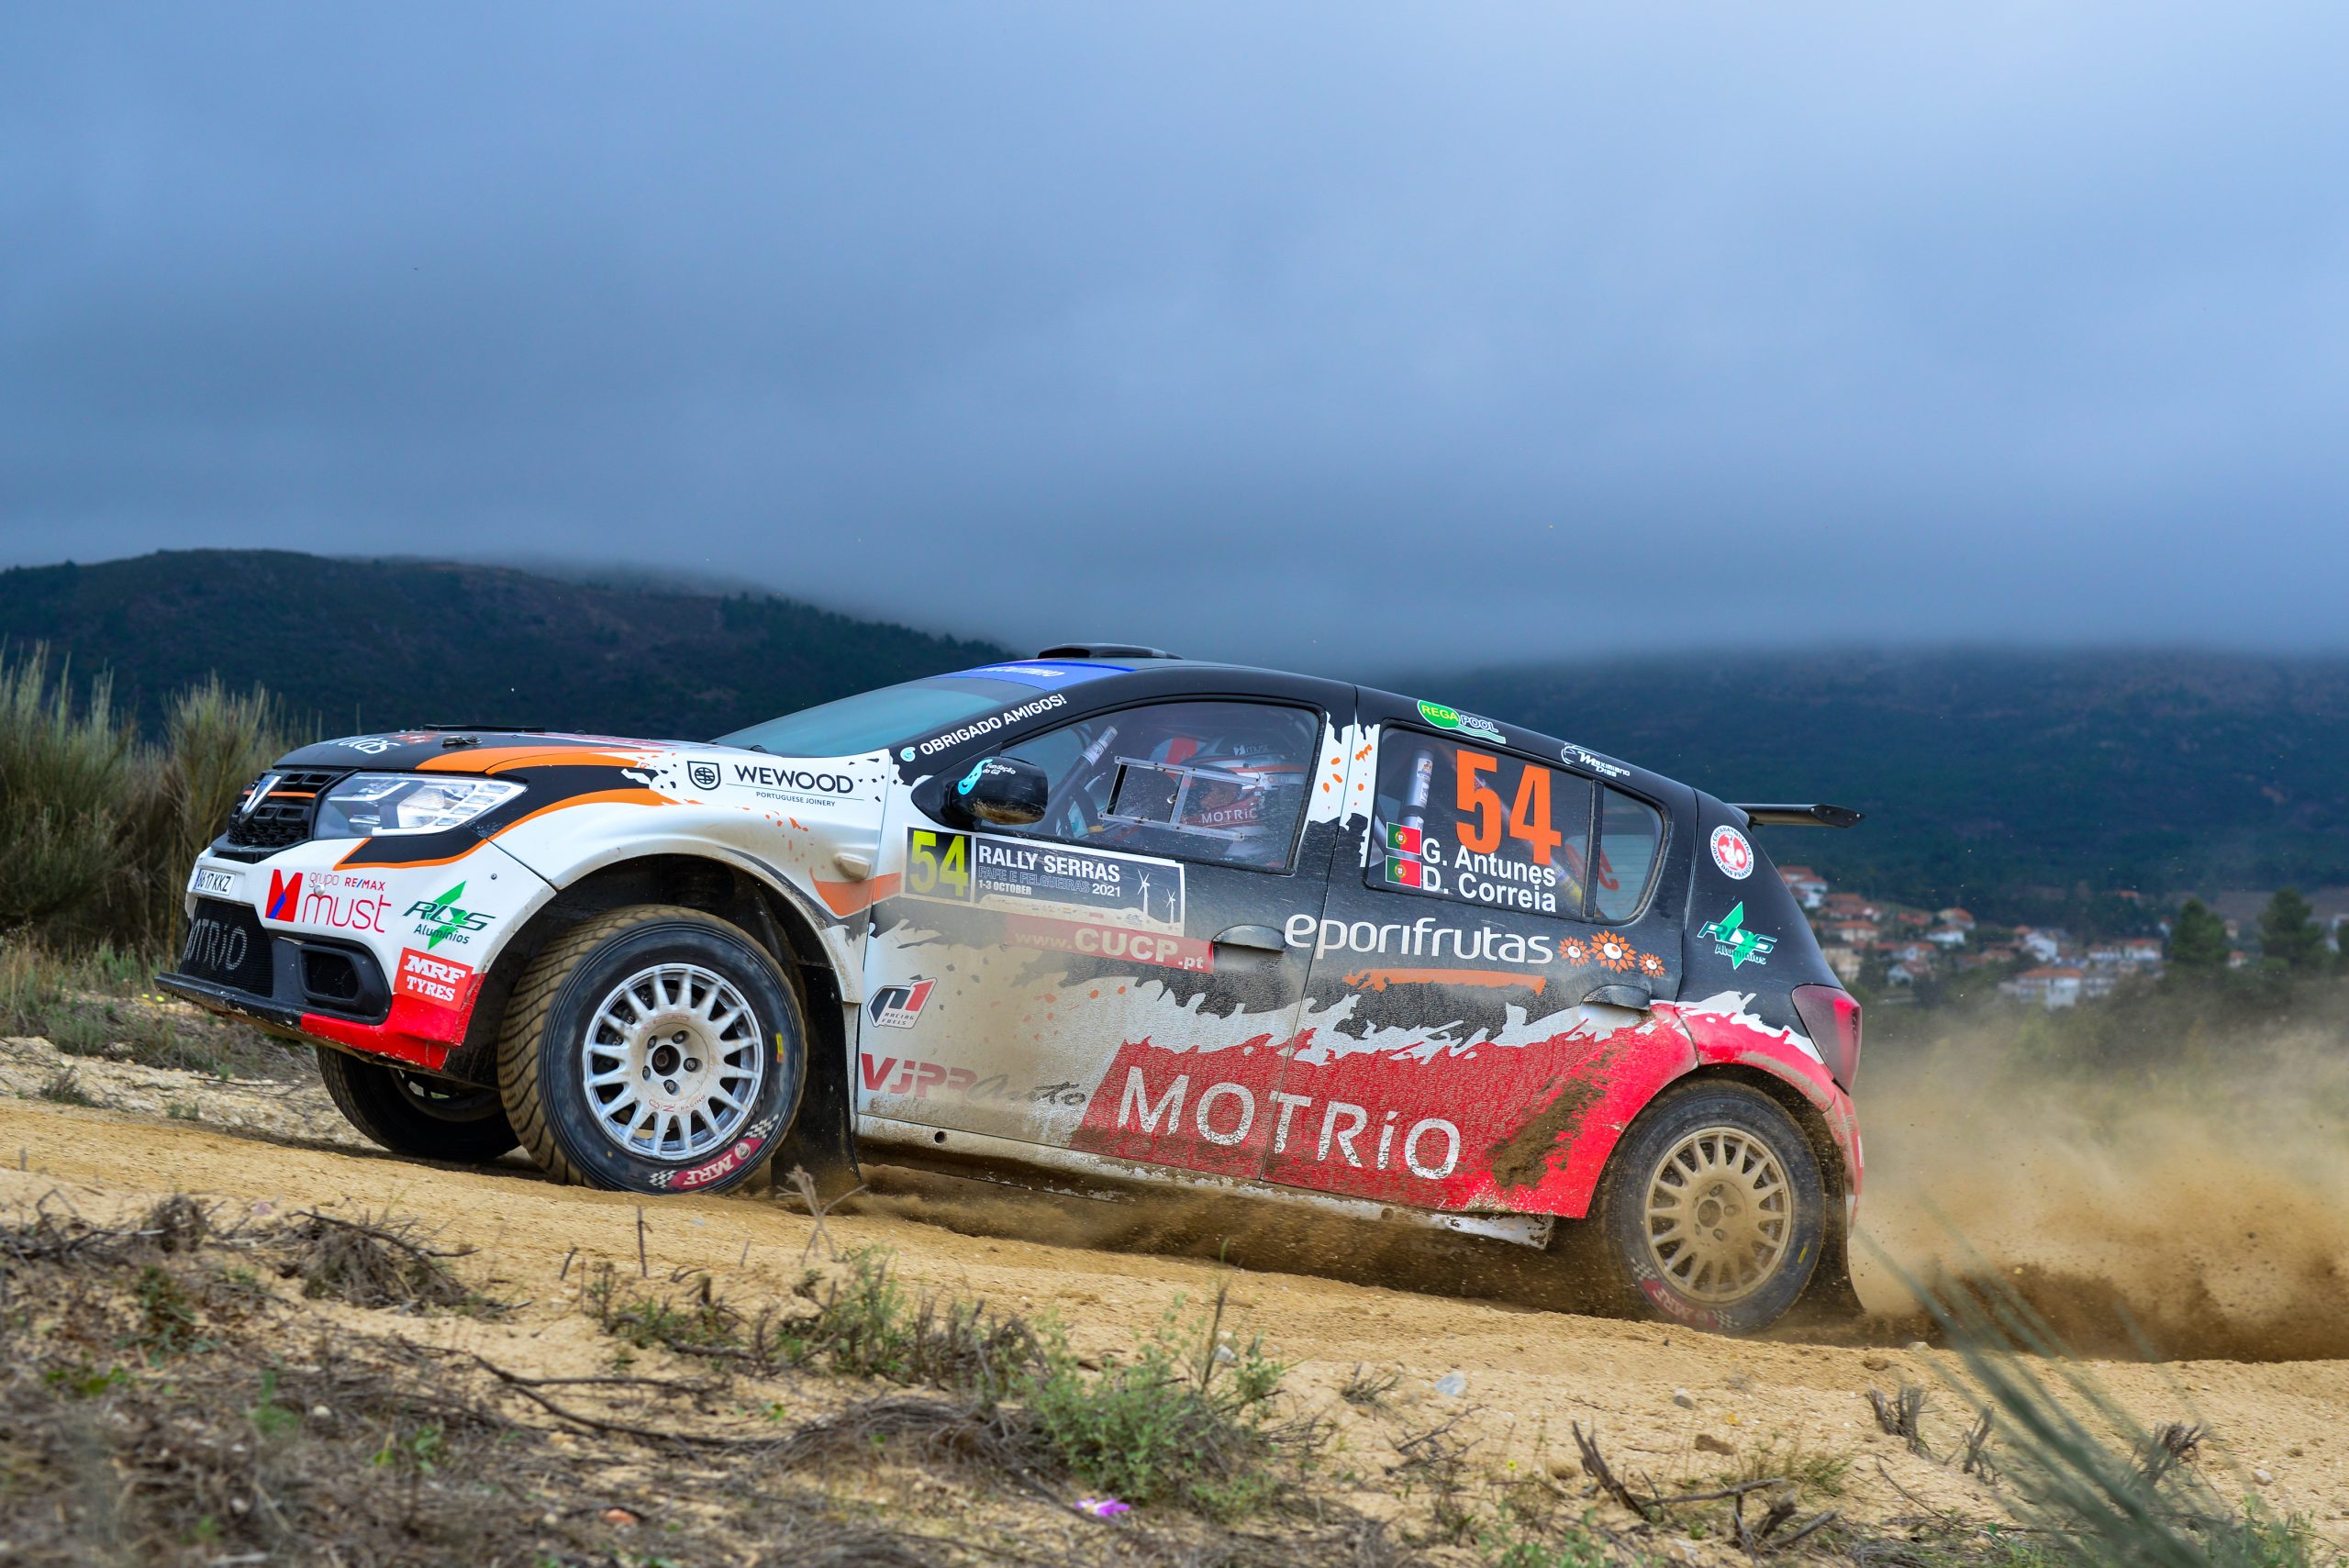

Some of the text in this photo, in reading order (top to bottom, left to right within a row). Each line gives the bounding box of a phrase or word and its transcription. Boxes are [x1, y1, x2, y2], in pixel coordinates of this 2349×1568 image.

[920, 694, 1067, 755] OBRIGADO AMIGOS!
[1421, 705, 1499, 733] REGA POOL
[734, 764, 854, 794] WEWOOD
[985, 762, 1017, 774] Fundação
[756, 791, 836, 807] PORTUGUESE JOINERY
[1456, 749, 1562, 866] 54
[910, 829, 969, 897] 54
[979, 845, 1120, 883] RALLY SERRAS
[1422, 838, 1556, 887] G. Antunes
[212, 874, 231, 892] KKZ
[308, 872, 385, 892] grupo RE/MAX
[978, 879, 1032, 895] 1-3 OCTOBER
[979, 865, 1120, 897] FAFE E FELGUEIRAS 2021
[1422, 866, 1556, 913] D. Correia
[302, 894, 392, 933] must
[1015, 928, 1204, 971] www.CUCP.pt
[1284, 913, 1553, 964] eporifrutas
[404, 954, 466, 984] MRF
[406, 975, 456, 1002] TYRES
[683, 1153, 735, 1185] MRF
